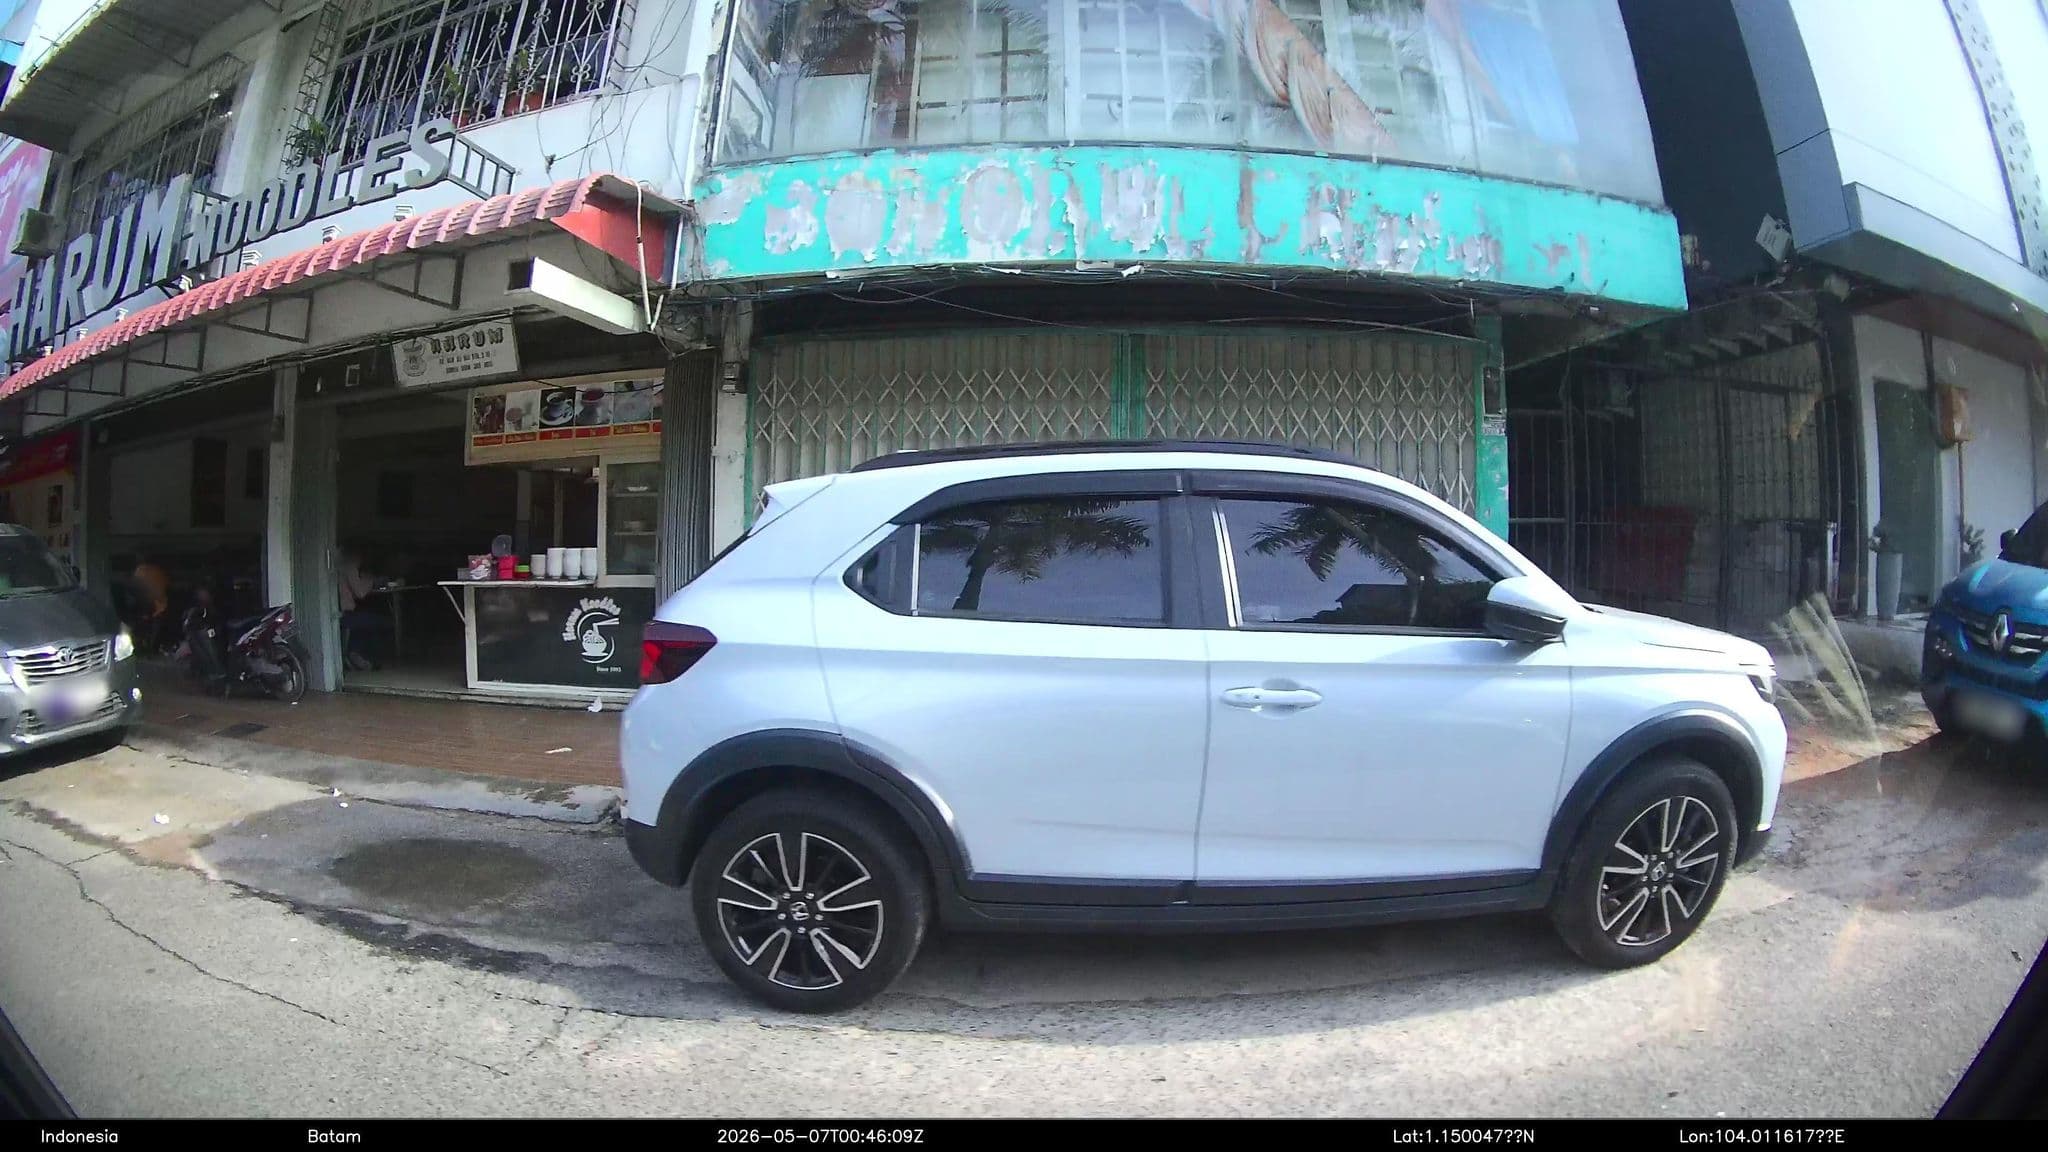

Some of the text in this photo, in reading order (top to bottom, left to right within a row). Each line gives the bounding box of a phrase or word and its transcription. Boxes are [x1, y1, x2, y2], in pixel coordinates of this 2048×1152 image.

[7, 118, 458, 359] HARUM NOODLES
[430, 327, 504, 354] HARUM
